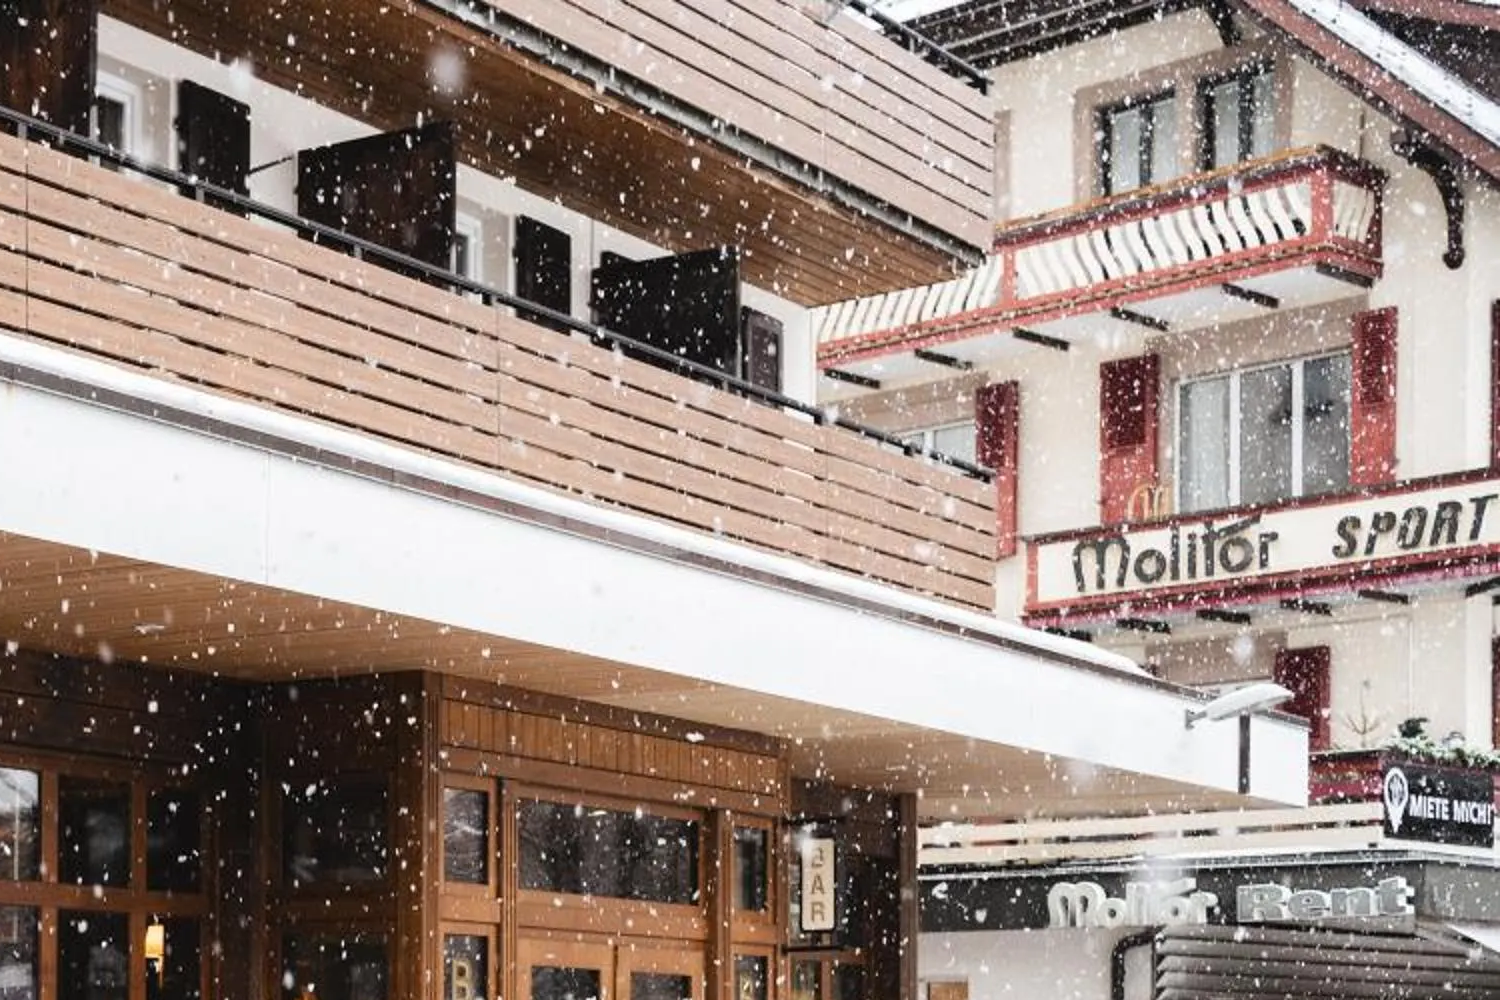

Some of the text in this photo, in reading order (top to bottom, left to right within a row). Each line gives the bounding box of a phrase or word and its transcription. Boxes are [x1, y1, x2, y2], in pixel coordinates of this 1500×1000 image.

[1073, 494, 1499, 592] Molitor SPORT
[1409, 794, 1449, 821] MIETE
